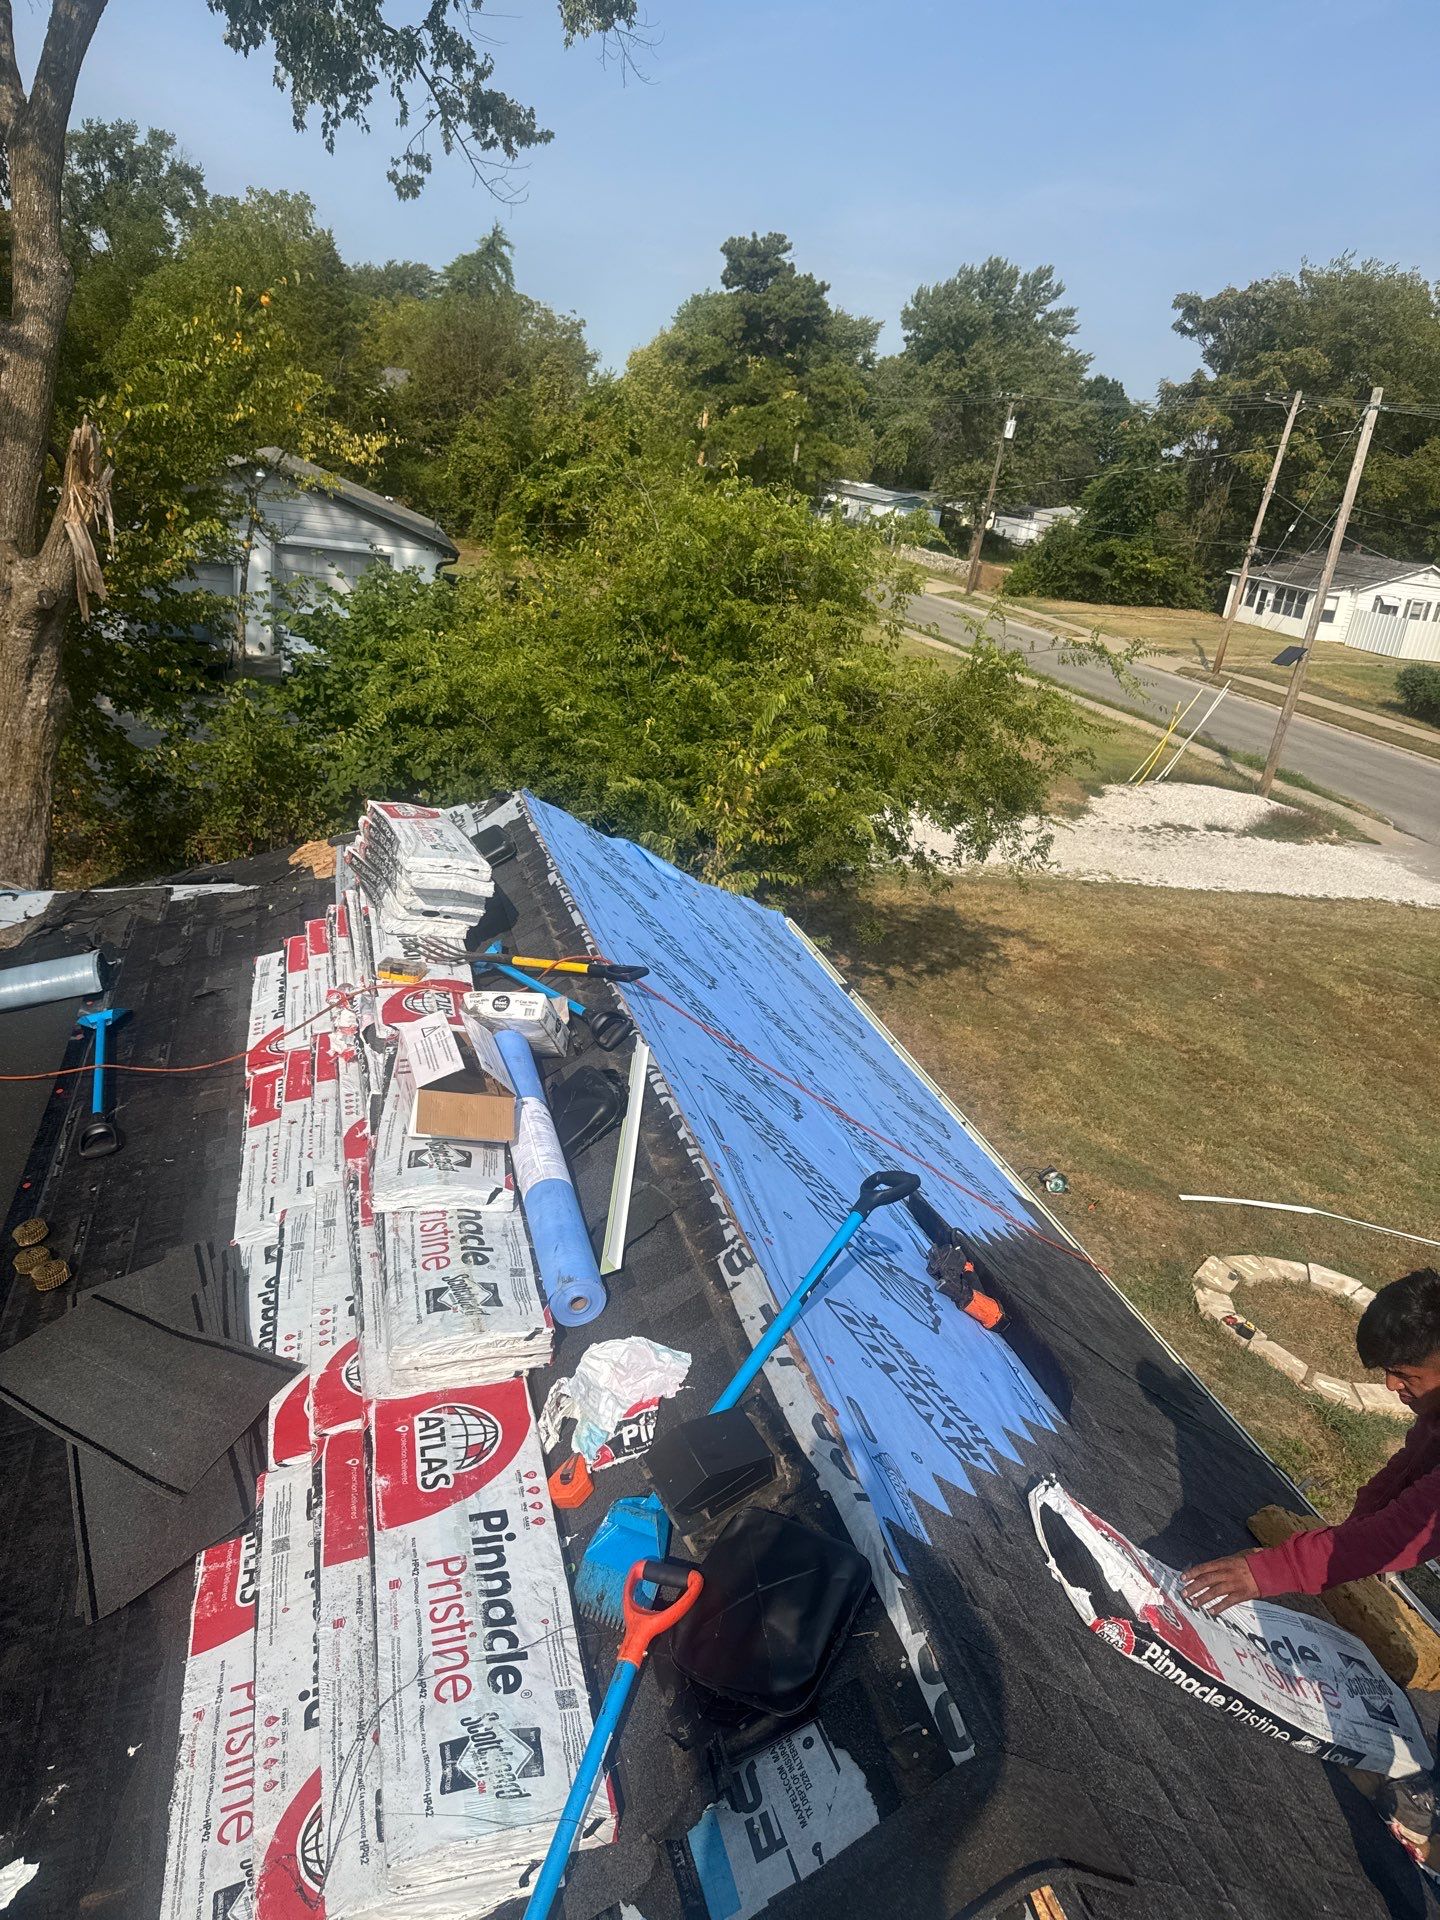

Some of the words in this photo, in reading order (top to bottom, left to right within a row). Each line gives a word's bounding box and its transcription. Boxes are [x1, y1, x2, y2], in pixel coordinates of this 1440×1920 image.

[420, 1209, 455, 1271] ristine
[400, 1433, 409, 1459] Protection
[418, 1416, 451, 1490] ATLAS
[400, 1459, 409, 1485] Delivered
[411, 1559, 420, 1577] HP42
[469, 1508, 529, 1695] Pinnacle
[426, 1555, 477, 1704] Pristine
[1097, 1629, 1125, 1651] ATLAS
[215, 1684, 225, 1705] HP42
[417, 1678, 427, 1699] HP42
[1141, 1641, 1228, 1709] Pinnacle
[1225, 1697, 1292, 1743] Pristine
[421, 1746, 428, 1754] LA
[478, 1780, 487, 1794] 3M
[789, 1772, 800, 1784] OF
[798, 1769, 813, 1790] D226
[423, 1792, 434, 1818] HP42
[803, 1804, 814, 1818] TX
[201, 1818, 213, 1843] HP42
[359, 1839, 370, 1866] HP42
[197, 1895, 205, 1905] LA
